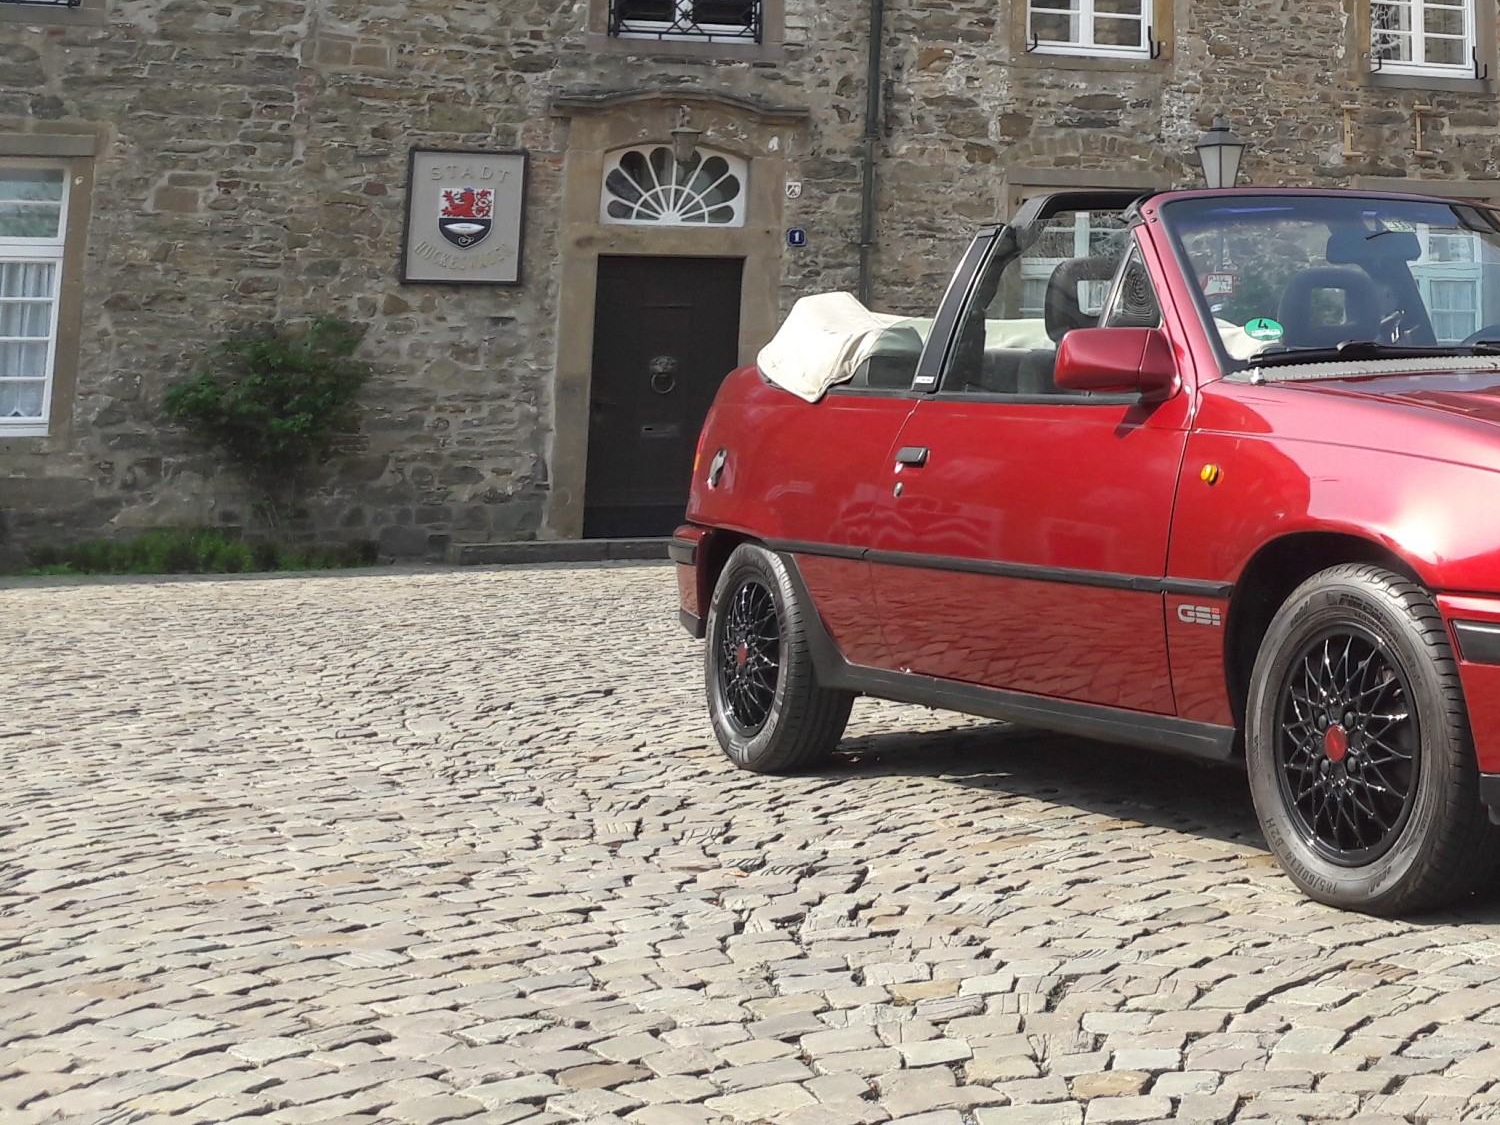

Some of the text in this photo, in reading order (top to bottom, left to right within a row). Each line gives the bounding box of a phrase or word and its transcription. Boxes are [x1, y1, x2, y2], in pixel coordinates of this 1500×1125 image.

[431, 165, 511, 183] STADT
[794, 231, 801, 243] 1
[1257, 318, 1269, 330] 4
[1177, 604, 1221, 626] GSi
